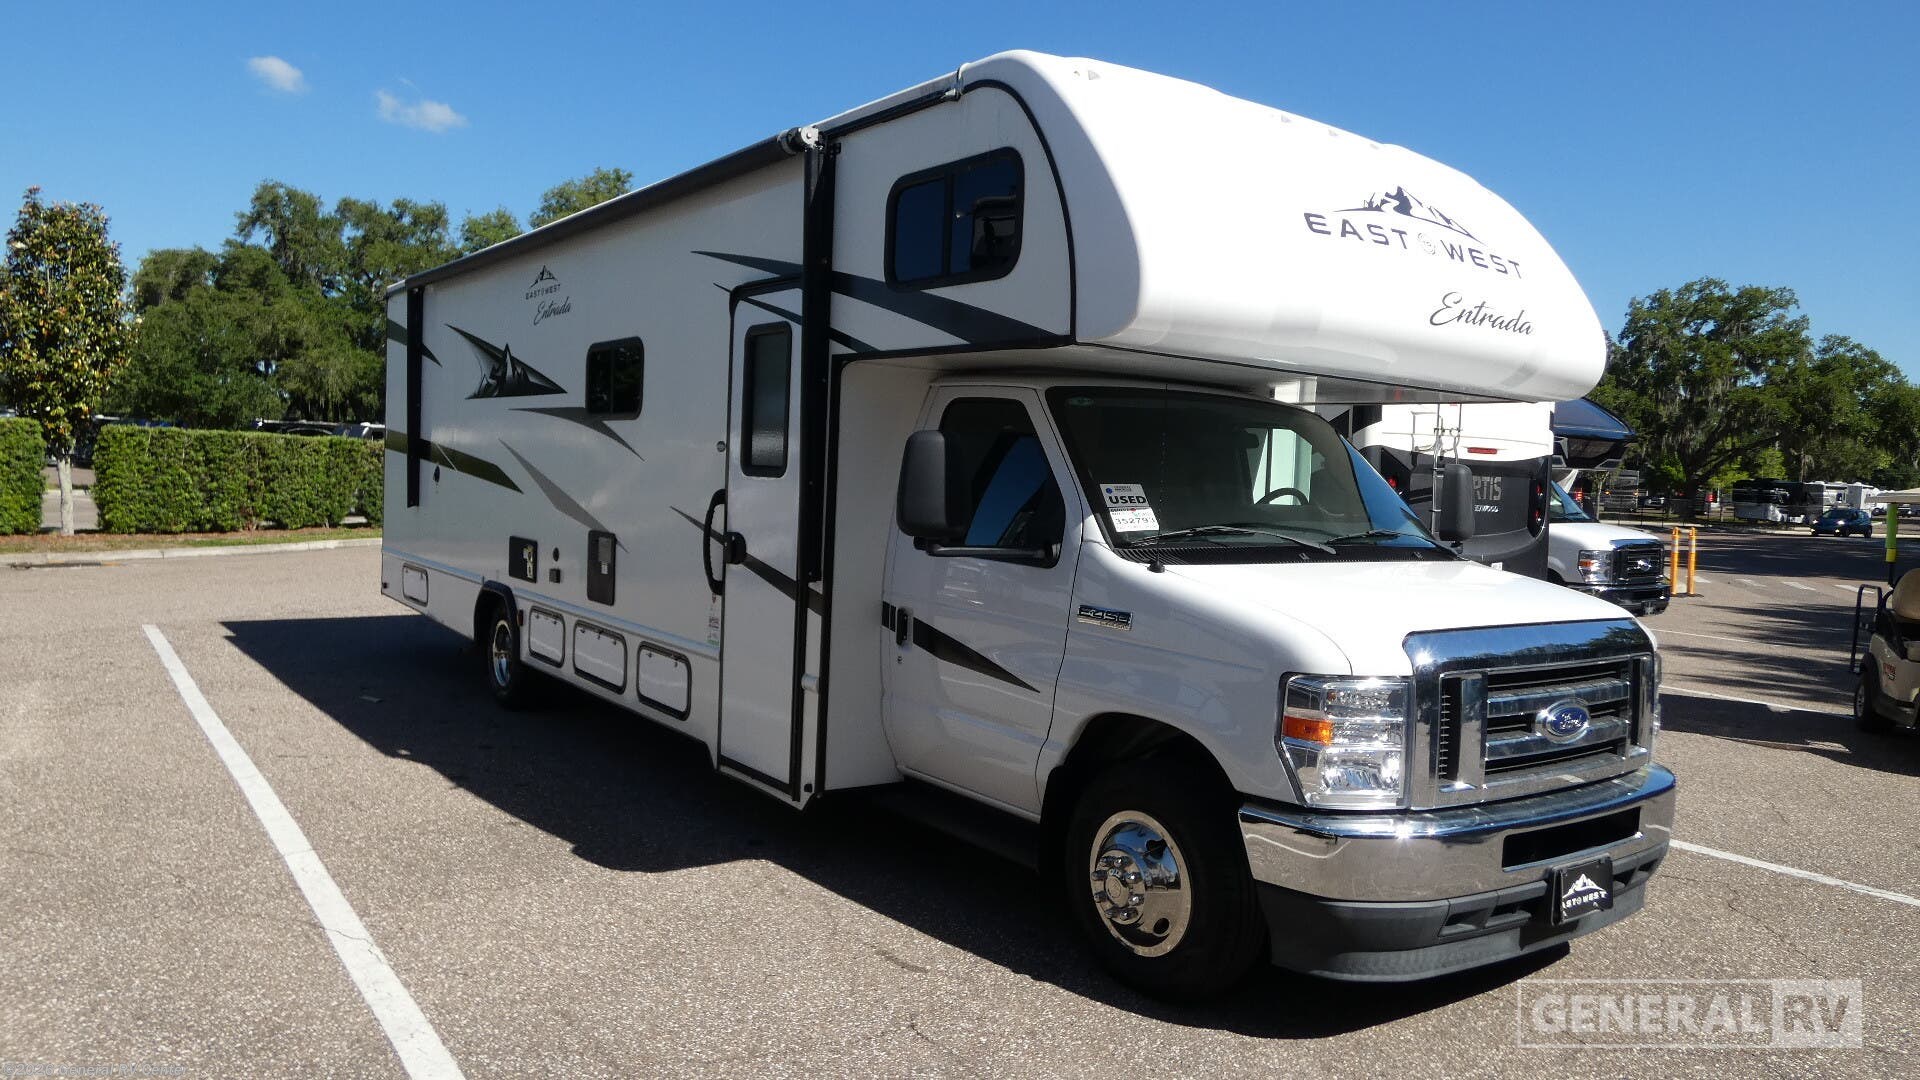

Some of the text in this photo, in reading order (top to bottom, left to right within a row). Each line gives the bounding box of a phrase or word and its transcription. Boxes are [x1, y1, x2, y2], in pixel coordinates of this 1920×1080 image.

[1303, 212, 1522, 279] EAST WEST
[533, 296, 571, 326] Entrada
[1429, 291, 1535, 335] Entrada
[1108, 495, 1147, 505] USED
[1583, 890, 1607, 903] WEST
